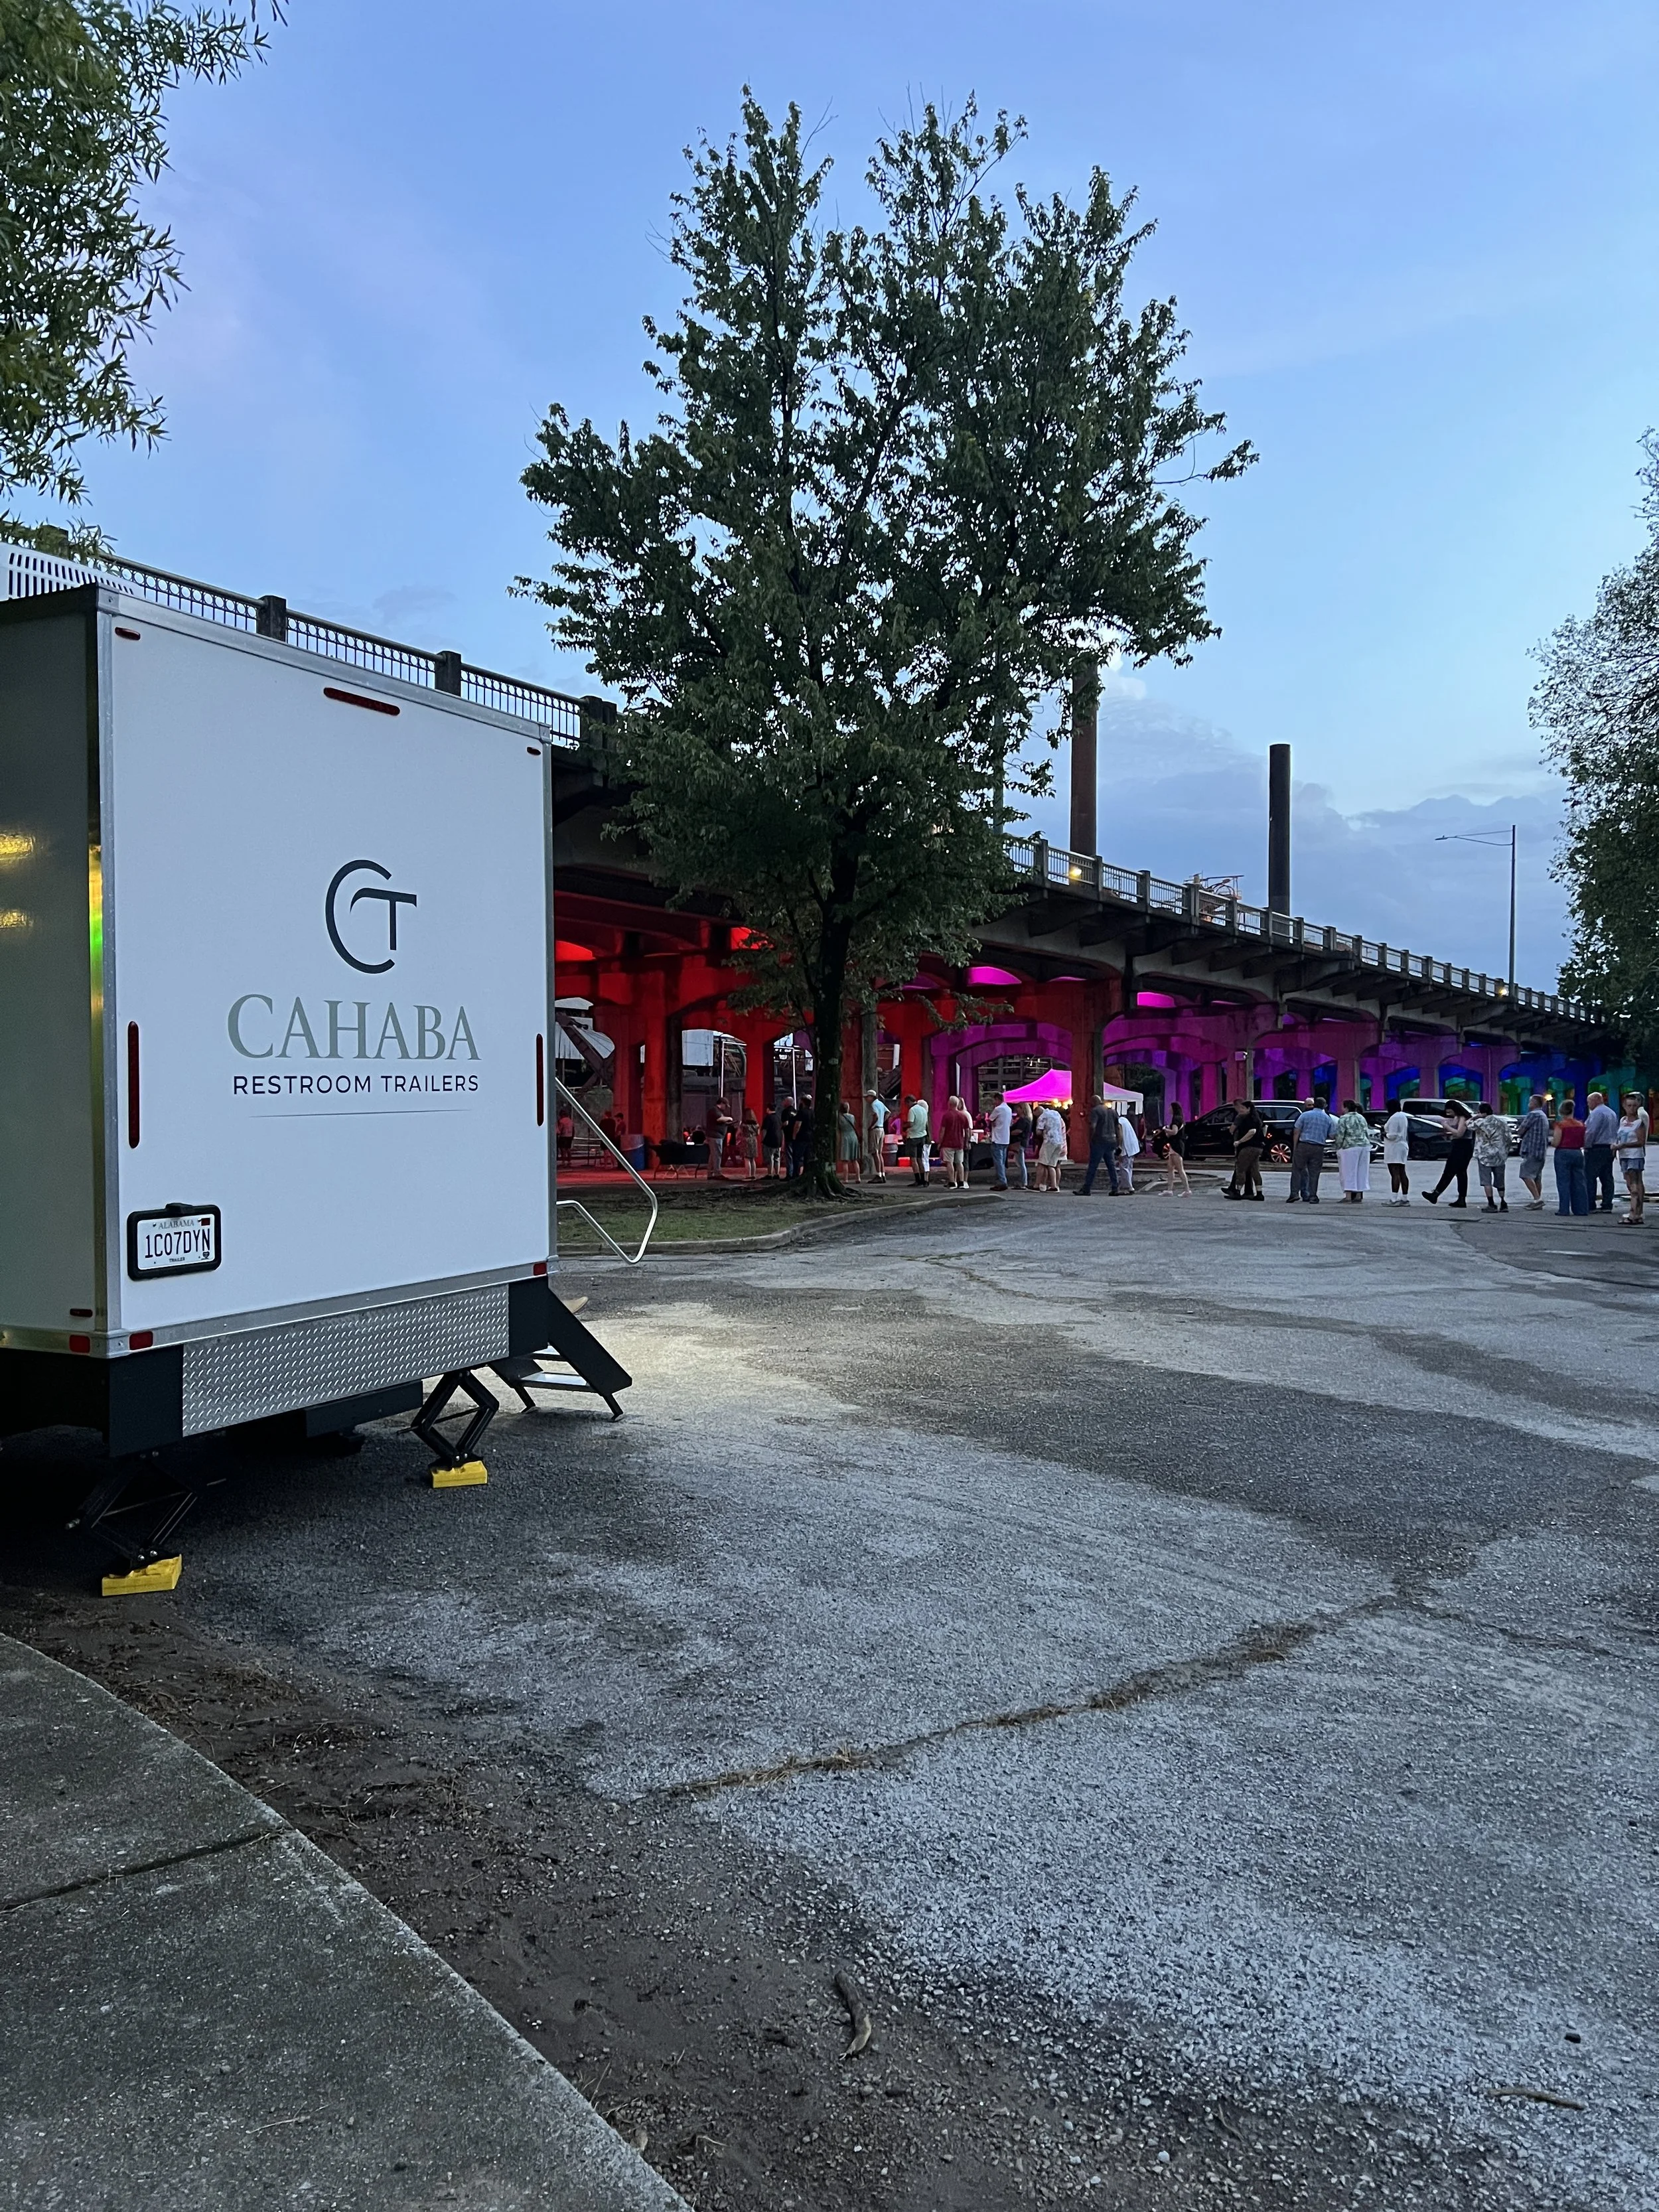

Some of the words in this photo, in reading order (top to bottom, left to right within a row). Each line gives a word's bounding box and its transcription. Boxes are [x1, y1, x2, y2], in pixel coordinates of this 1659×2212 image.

[227, 994, 482, 1060] CAHABA
[234, 1074, 372, 1095] RESTROOM
[380, 1074, 478, 1092] TRAILERS
[158, 1219, 194, 1229] ALABAMA
